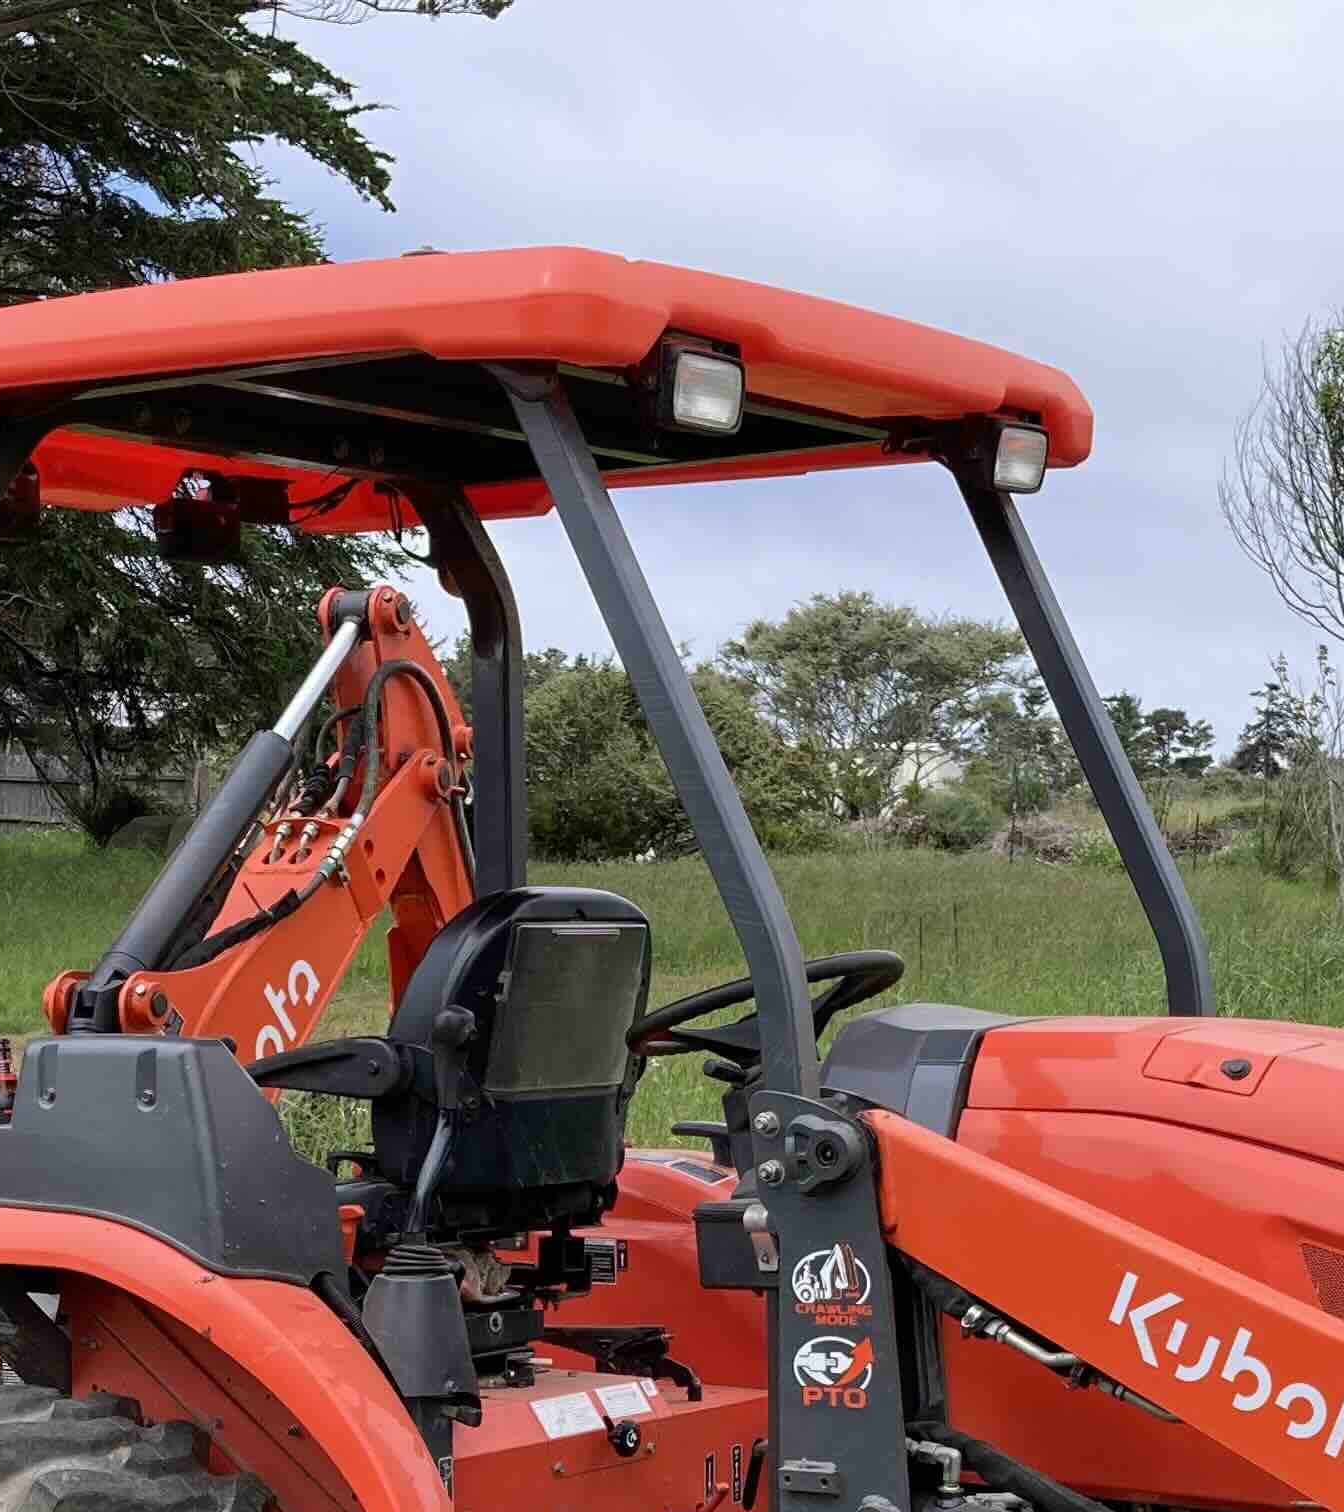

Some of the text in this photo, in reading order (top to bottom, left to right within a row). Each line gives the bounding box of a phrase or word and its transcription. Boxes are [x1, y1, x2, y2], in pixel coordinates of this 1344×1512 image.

[256, 960, 320, 1060] ota
[815, 1314, 857, 1325] MODE
[802, 1386, 867, 1408] PTO
